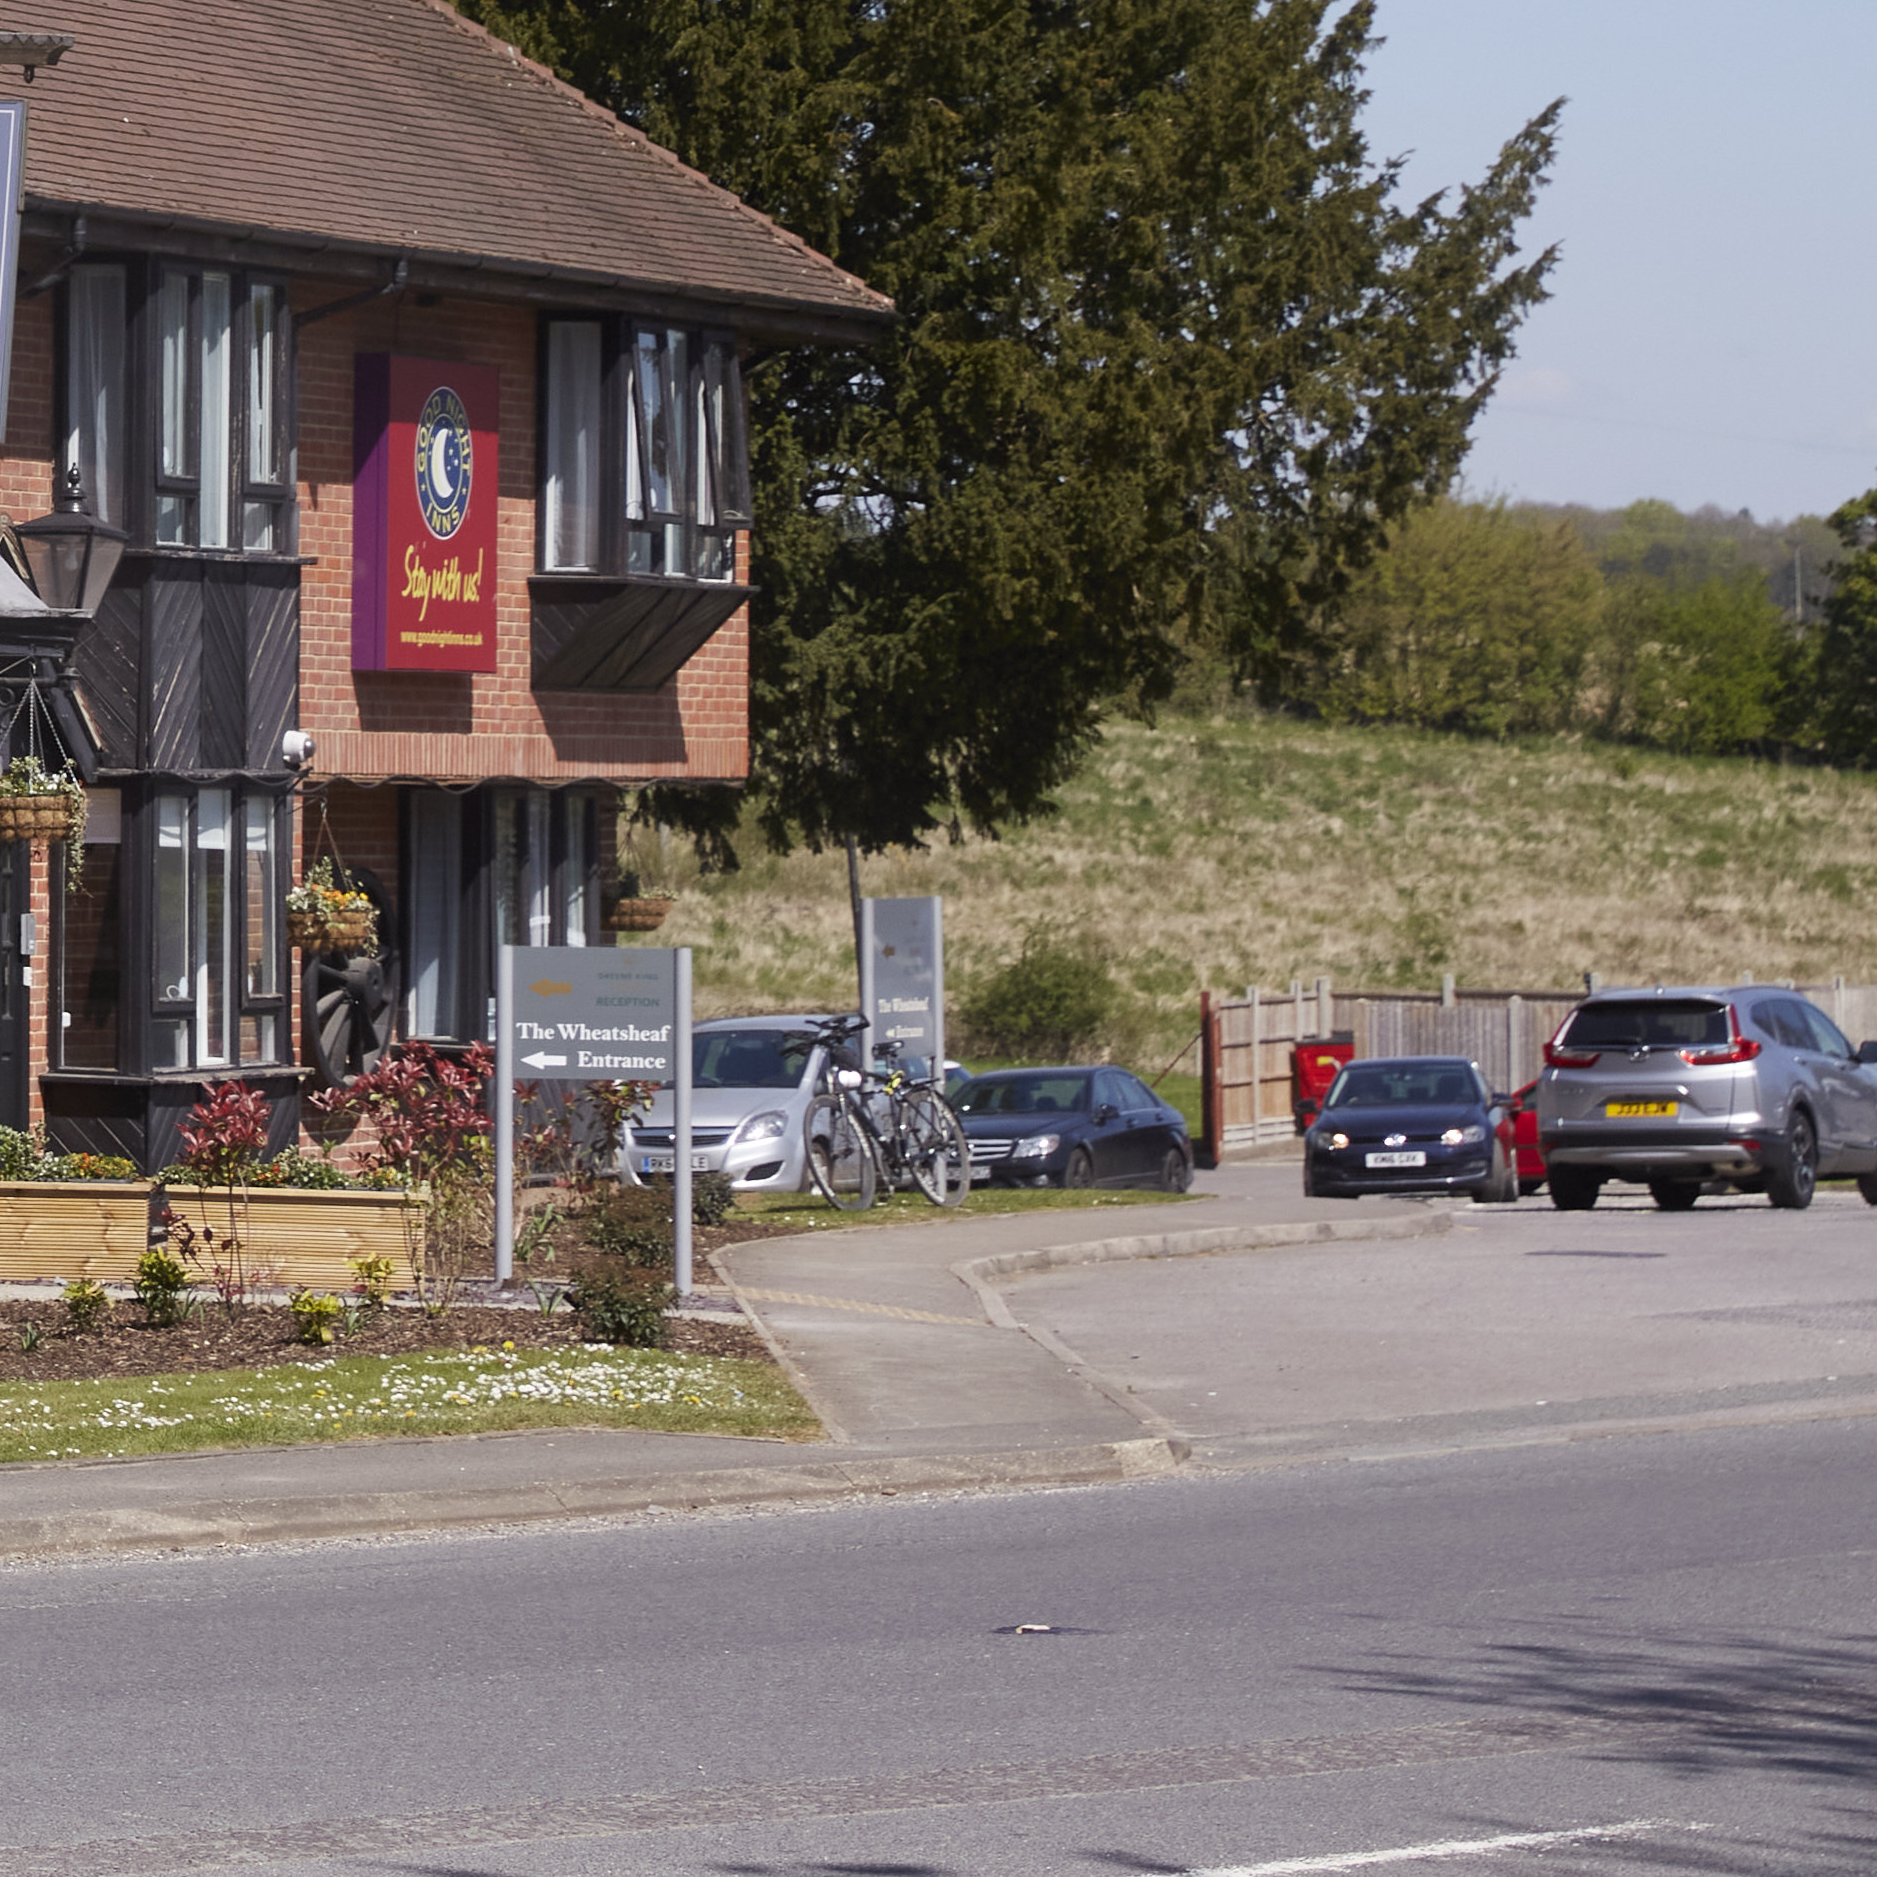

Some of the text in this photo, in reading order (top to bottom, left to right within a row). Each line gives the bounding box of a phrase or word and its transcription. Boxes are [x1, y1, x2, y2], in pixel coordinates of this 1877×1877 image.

[417, 395, 442, 473] GOOD
[426, 506, 460, 532] INNS
[401, 544, 431, 622] Stay
[432, 556, 461, 602] with
[596, 997, 660, 1007] RECEPTION
[516, 1022, 672, 1042] The Wheatsheaf
[577, 1050, 666, 1069] Entrance
